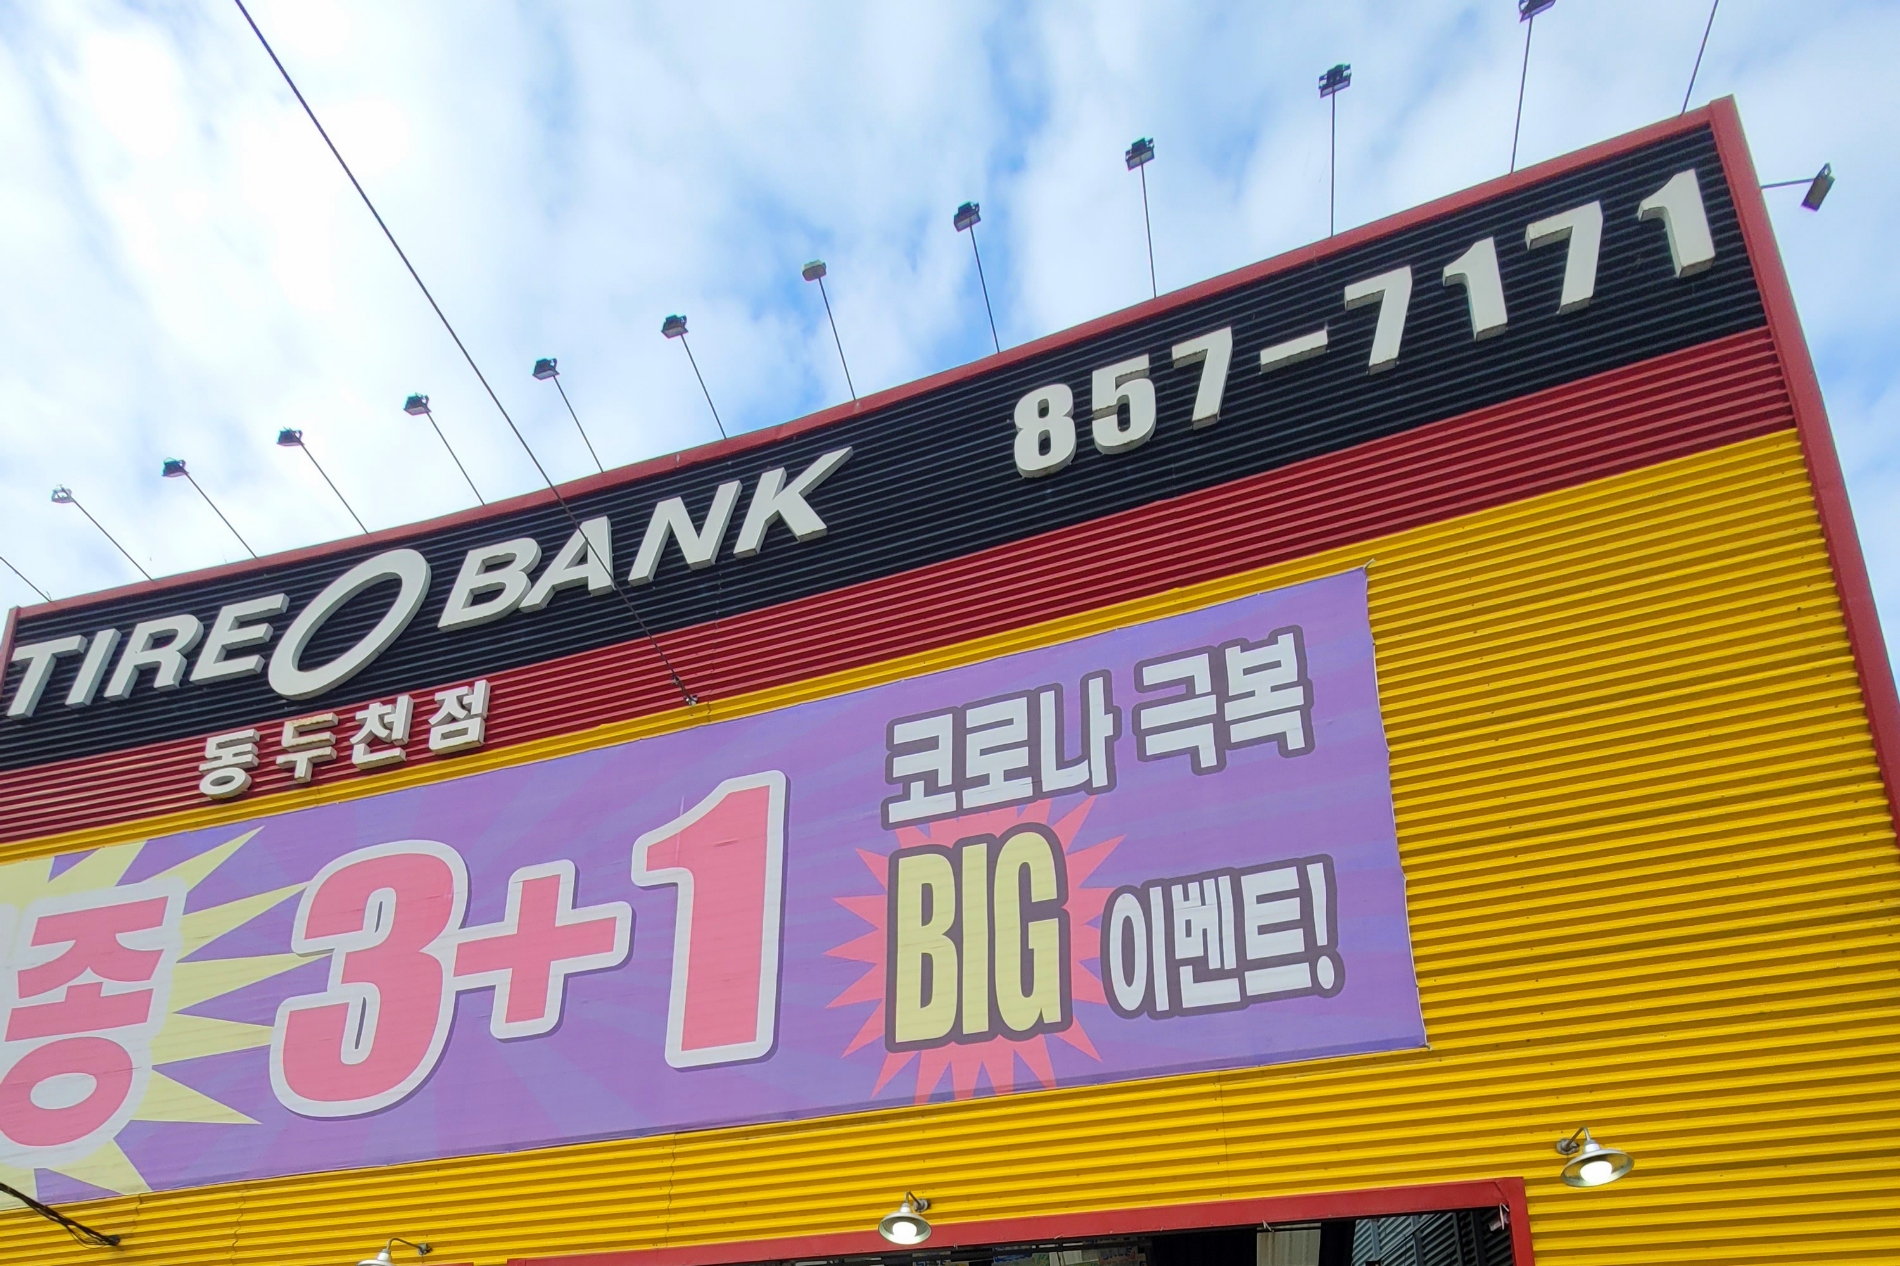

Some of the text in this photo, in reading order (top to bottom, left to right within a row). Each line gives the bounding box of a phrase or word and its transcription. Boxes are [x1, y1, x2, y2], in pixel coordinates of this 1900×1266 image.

[1012, 169, 1717, 477] 857-7171
[199, 678, 492, 800] 동두천점
[885, 628, 1310, 825] 코로나 극복
[270, 770, 788, 1118] 3+1
[890, 826, 1342, 1048] BIG 이벤트!
